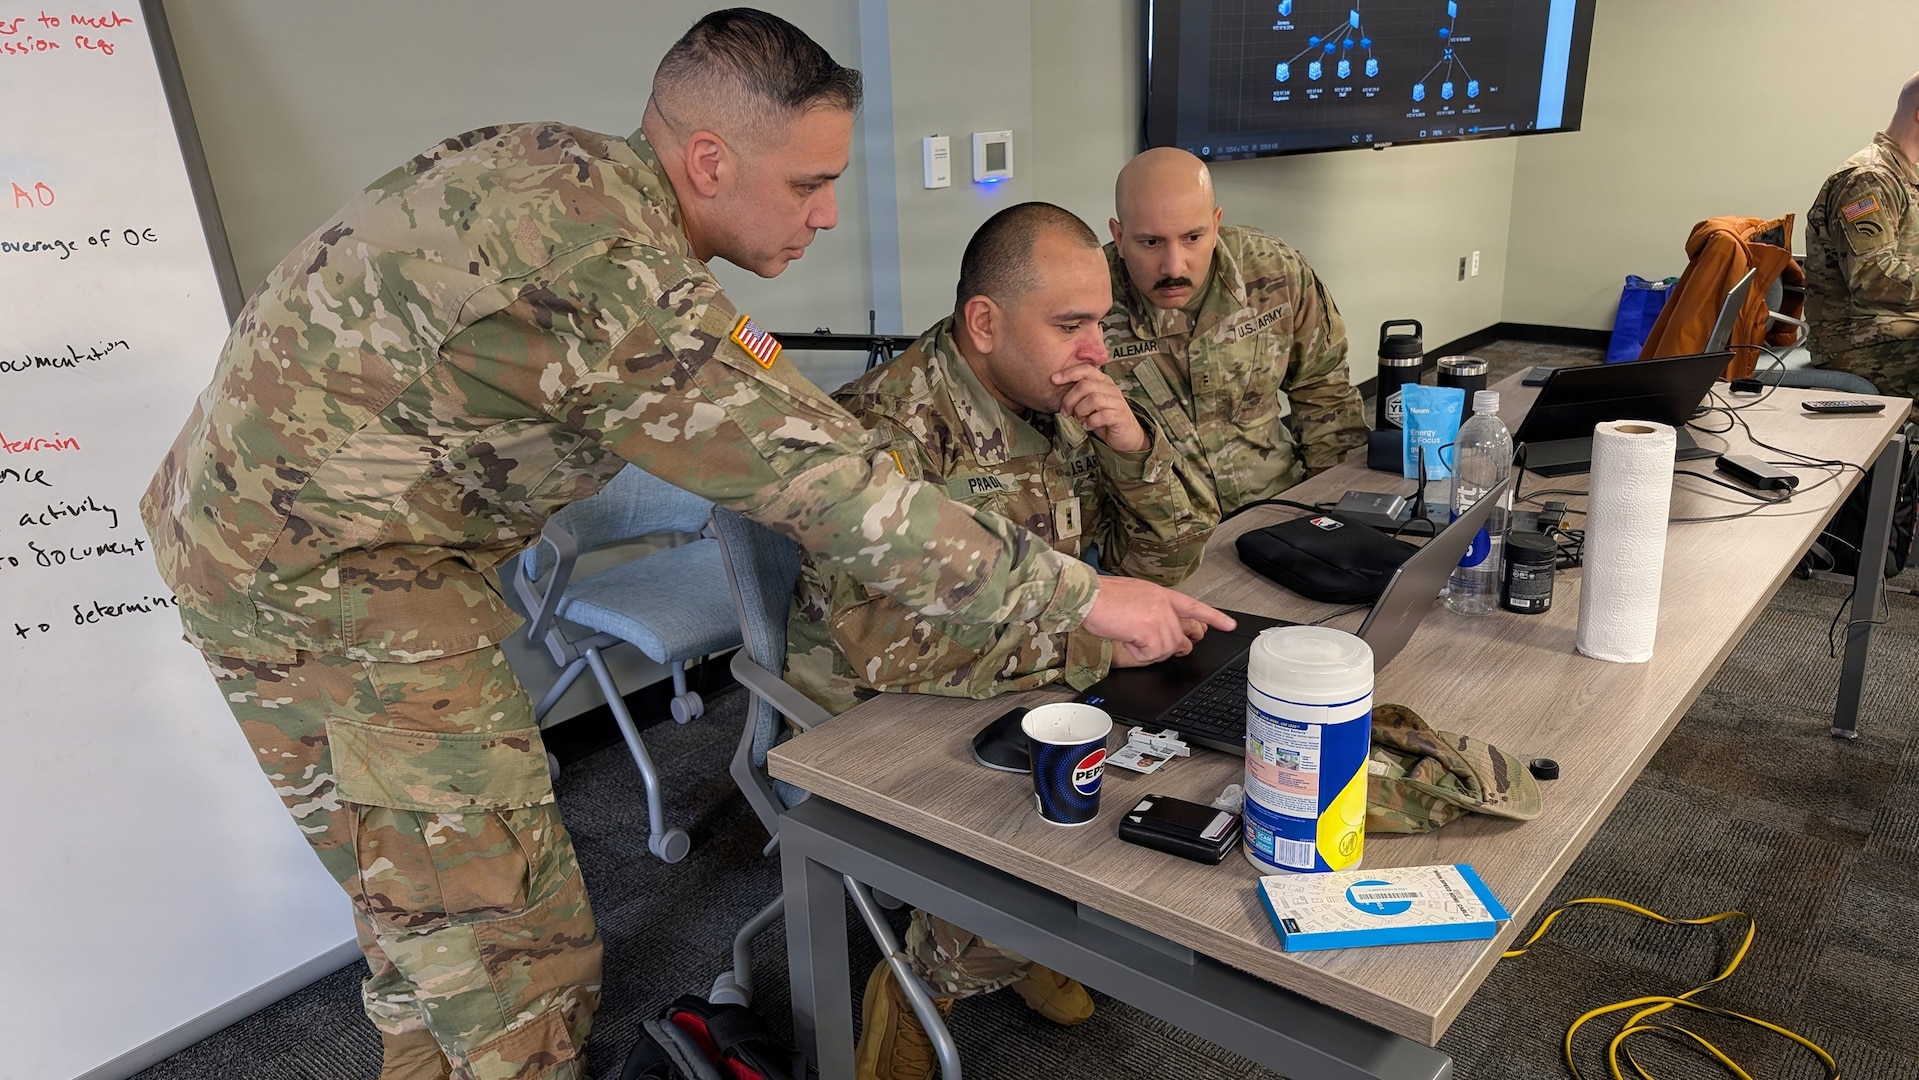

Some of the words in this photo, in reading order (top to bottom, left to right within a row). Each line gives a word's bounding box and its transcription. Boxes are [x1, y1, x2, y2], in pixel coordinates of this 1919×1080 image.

[37, 10, 60, 29] to
[71, 10, 133, 28] meet
[0, 35, 60, 55] ssion
[12, 182, 55, 208] AO
[88, 229, 111, 247] of
[1238, 322, 1257, 338] U.S.
[1257, 307, 1283, 330] ARMY
[1112, 341, 1158, 359] ALEMAR
[0, 432, 81, 454] terrain
[1410, 429, 1437, 438] Energy
[1410, 436, 1417, 444] &
[0, 468, 54, 486] nce
[19, 495, 118, 529] activity
[28, 537, 146, 568] document
[15, 622, 50, 639] to
